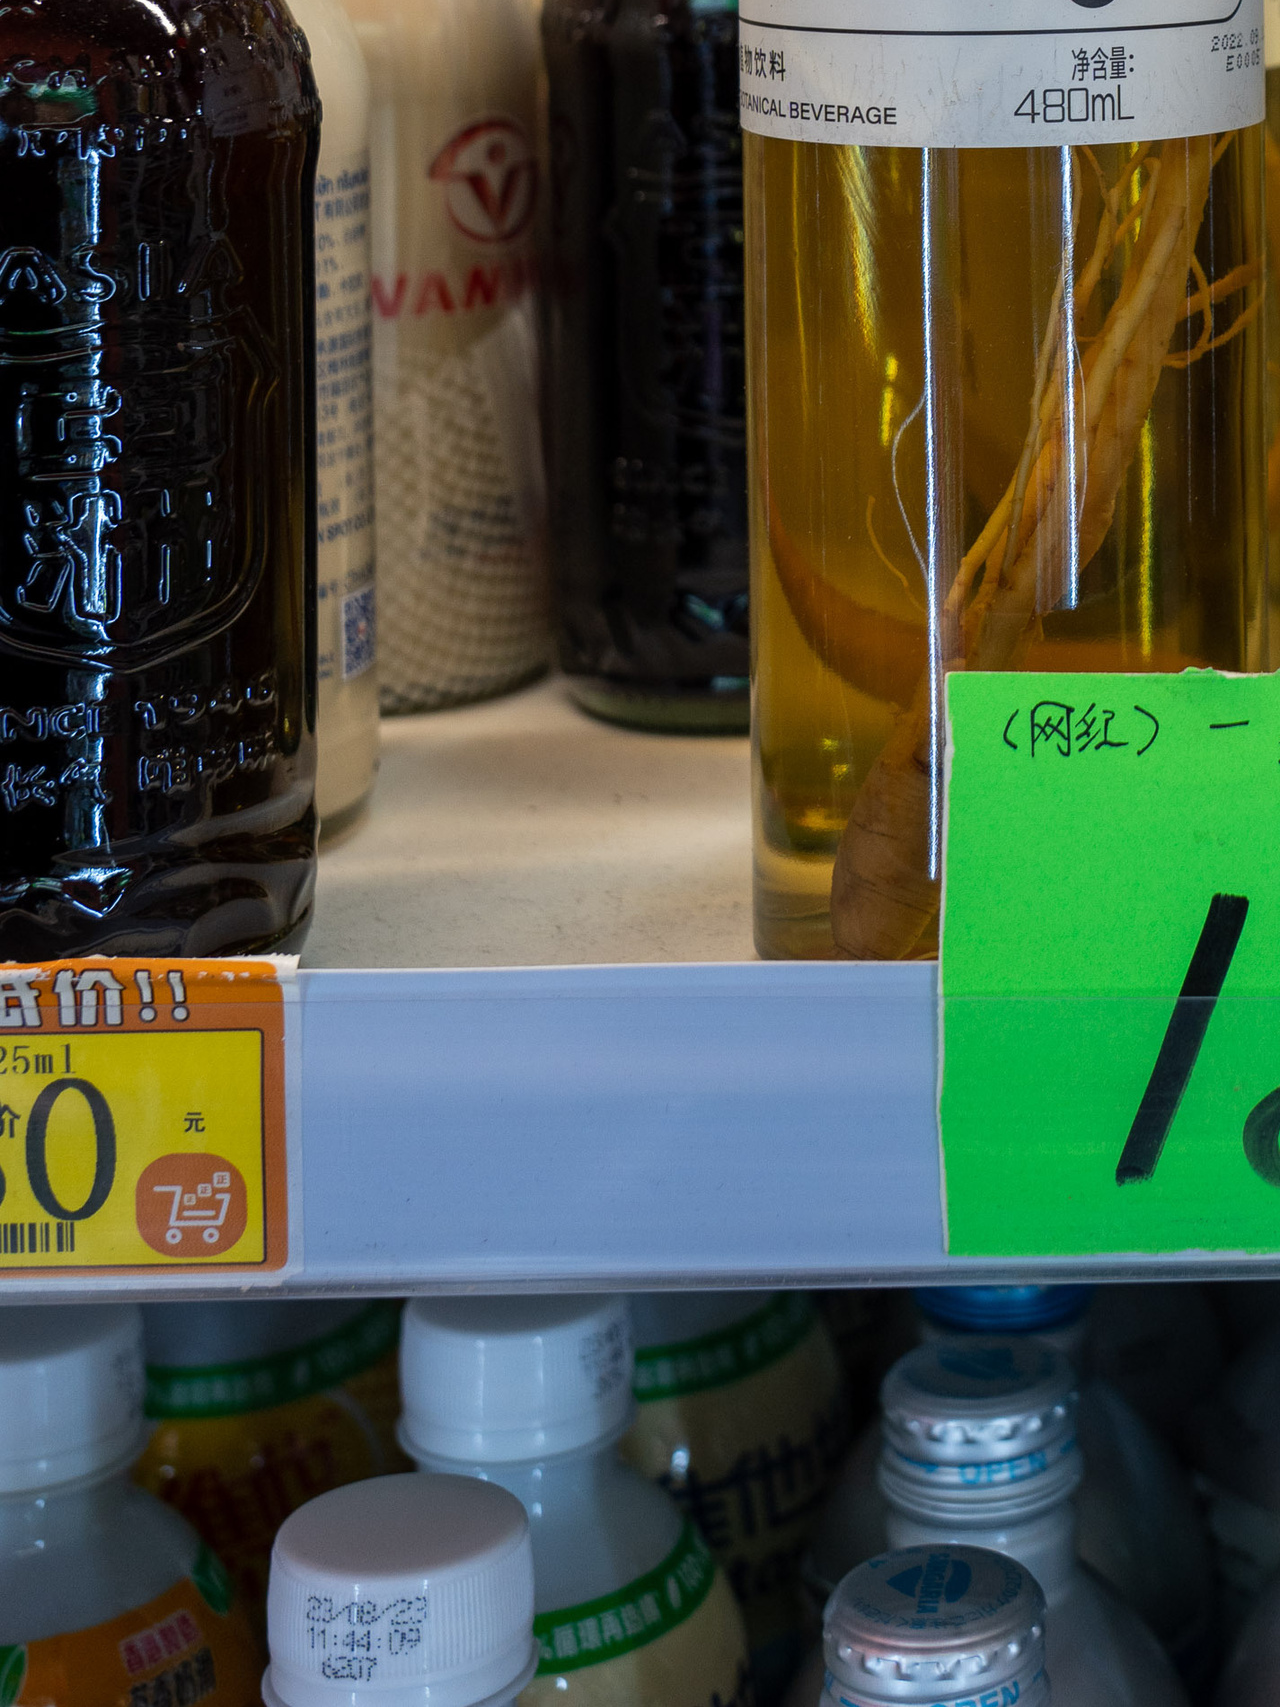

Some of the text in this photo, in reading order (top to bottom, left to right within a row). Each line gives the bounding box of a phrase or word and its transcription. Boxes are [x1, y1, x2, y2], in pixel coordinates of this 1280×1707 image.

[789, 101, 898, 126] BEVERAGE
[1014, 84, 1135, 124] 480mL
[184, 1112, 206, 1133] 元
